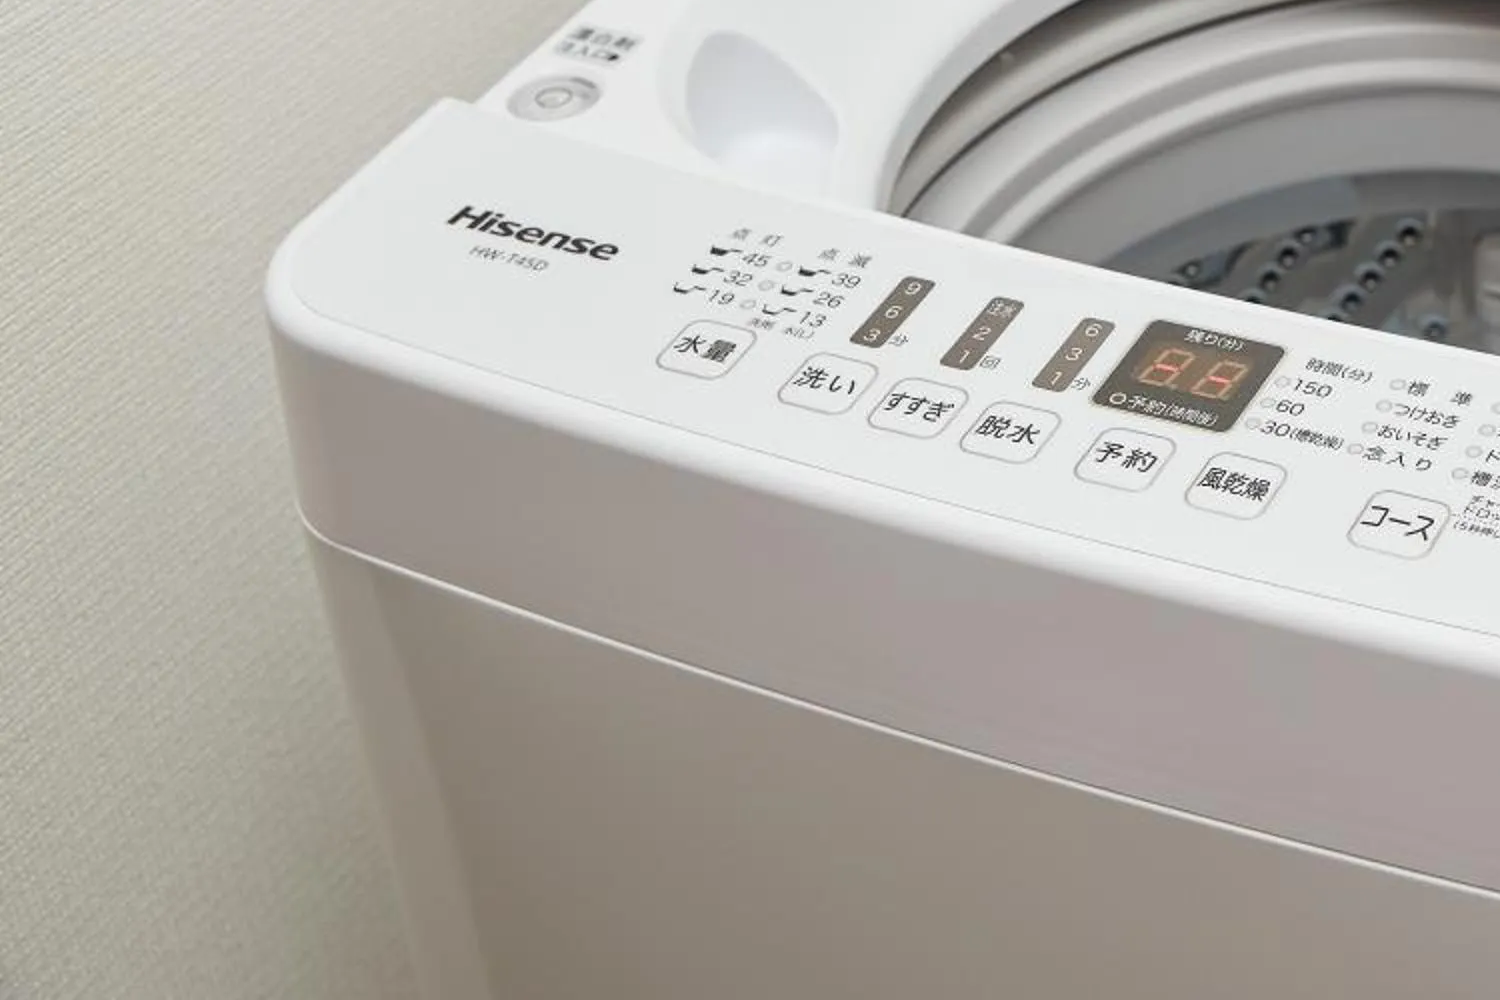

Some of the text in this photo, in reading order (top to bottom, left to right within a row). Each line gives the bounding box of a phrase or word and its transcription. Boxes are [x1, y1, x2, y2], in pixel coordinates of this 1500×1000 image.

[447, 205, 620, 260] Hisense
[469, 246, 549, 271] HW-T45D
[742, 253, 772, 268] 45
[723, 270, 753, 287] 32
[831, 273, 862, 288] 39
[709, 290, 735, 305] 19
[904, 282, 922, 295] 9
[812, 291, 845, 309] 26
[799, 311, 827, 328] 13
[886, 305, 902, 319] 6
[863, 328, 881, 342] 3
[972, 326, 992, 341] 2
[1084, 323, 1102, 338] 6
[673, 335, 737, 362] 水量
[1066, 347, 1083, 361] 3
[793, 366, 856, 395] 洗い
[1293, 378, 1333, 399] 150
[883, 390, 955, 423] すすぎ
[1275, 399, 1306, 417] 60
[1394, 402, 1461, 429] つけおき
[975, 415, 1041, 445] 脱水
[1377, 423, 1449, 450] おいそぎ
[1095, 441, 1157, 473] 予約
[1362, 445, 1432, 471] 念入り
[1197, 466, 1271, 502] 風乾燥
[1360, 505, 1435, 541] コース
